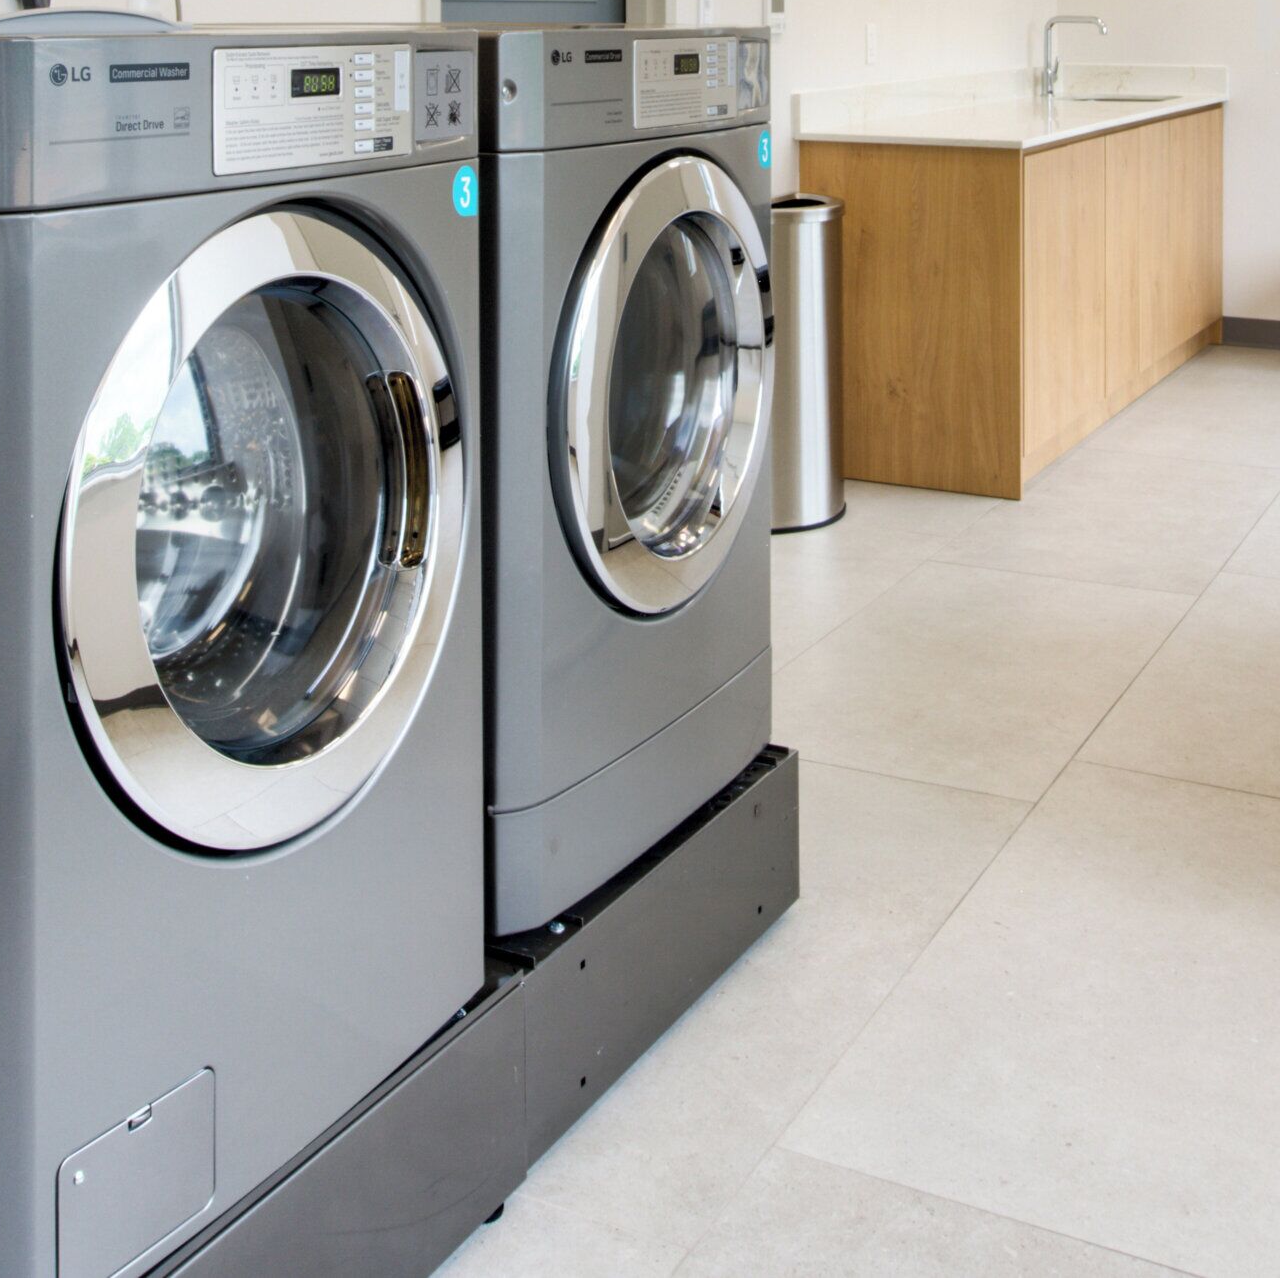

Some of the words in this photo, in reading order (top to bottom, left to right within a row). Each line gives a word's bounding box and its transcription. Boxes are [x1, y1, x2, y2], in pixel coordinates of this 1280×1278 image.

[562, 51, 573, 63] LG
[71, 65, 91, 83] LG
[111, 66, 157, 81] Commercial
[158, 64, 189, 79] Washer
[116, 120, 141, 132] Direct
[143, 116, 165, 130] Drive
[761, 139, 769, 163] 3
[460, 176, 471, 208] 3
